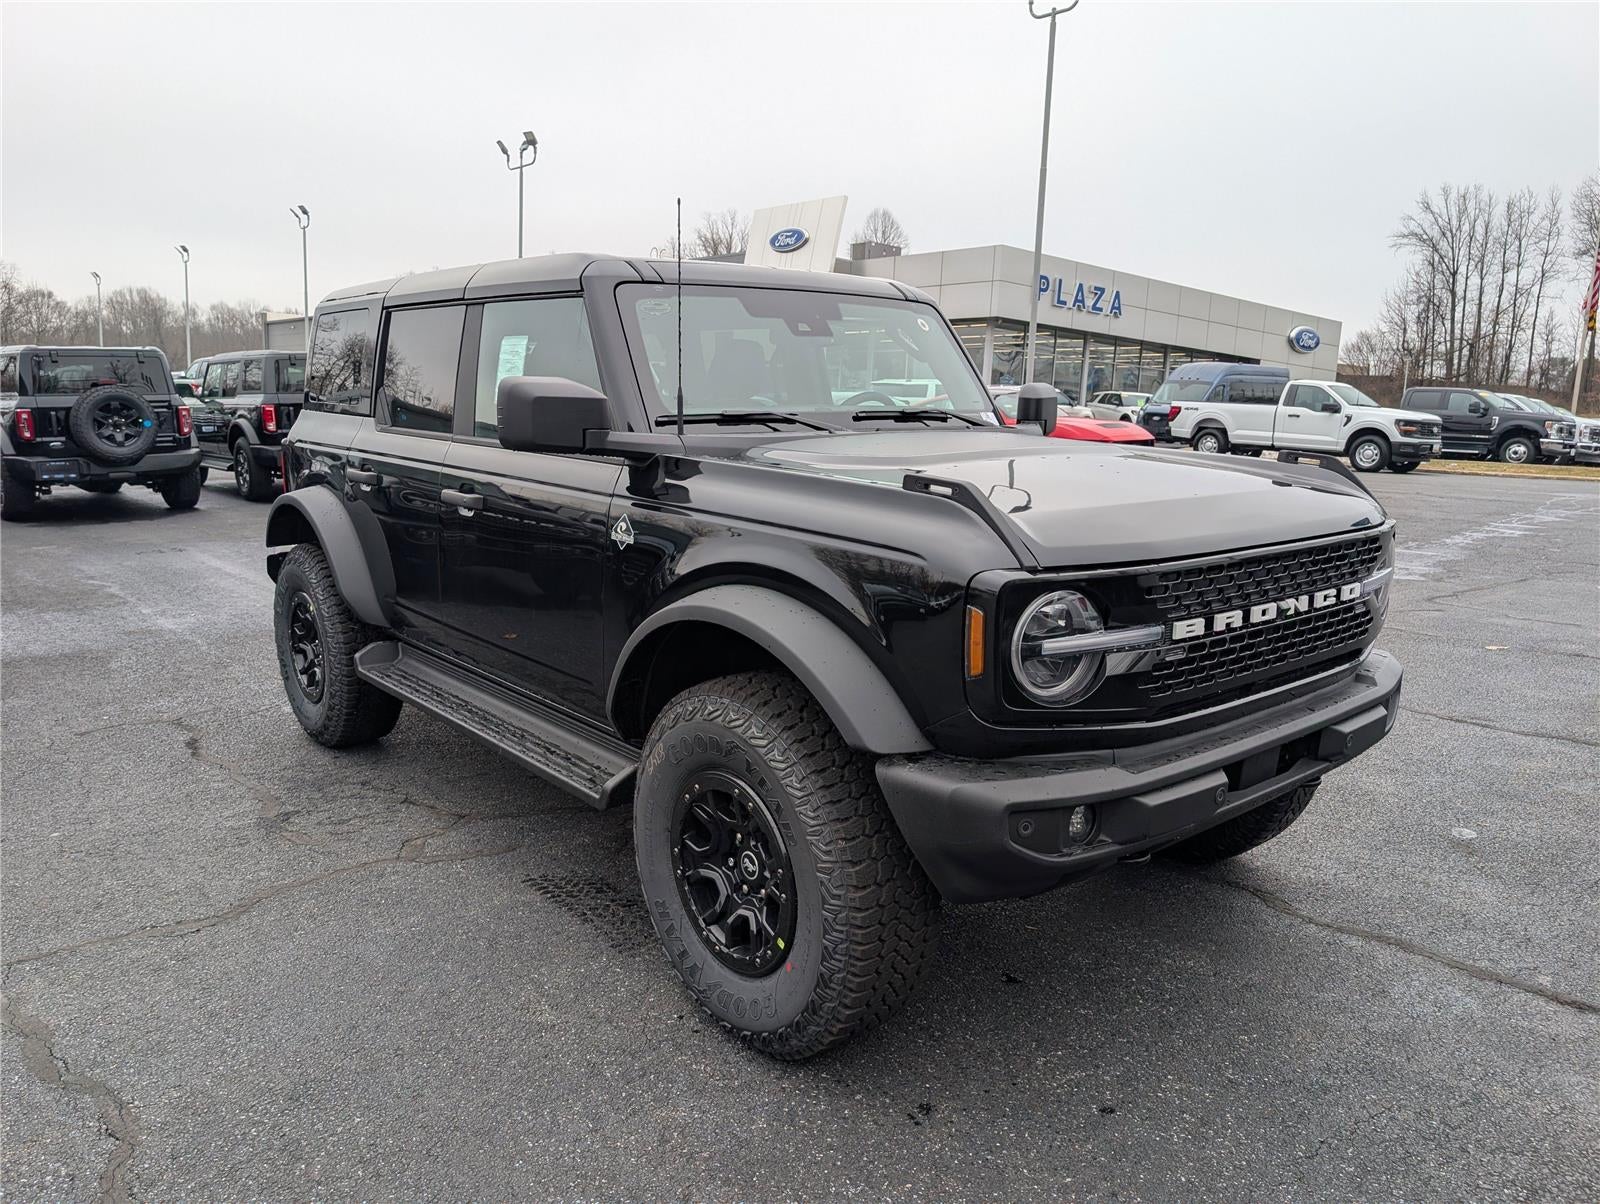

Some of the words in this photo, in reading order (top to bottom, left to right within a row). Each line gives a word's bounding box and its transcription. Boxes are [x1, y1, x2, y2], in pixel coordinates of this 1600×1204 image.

[774, 231, 798, 247] Ford
[1038, 274, 1122, 316] PLAZA
[1299, 331, 1318, 348] Ford
[1171, 581, 1362, 641] BRONCO
[667, 733, 798, 848] GOODYEAR
[654, 898, 778, 1022] GOODYEAR
